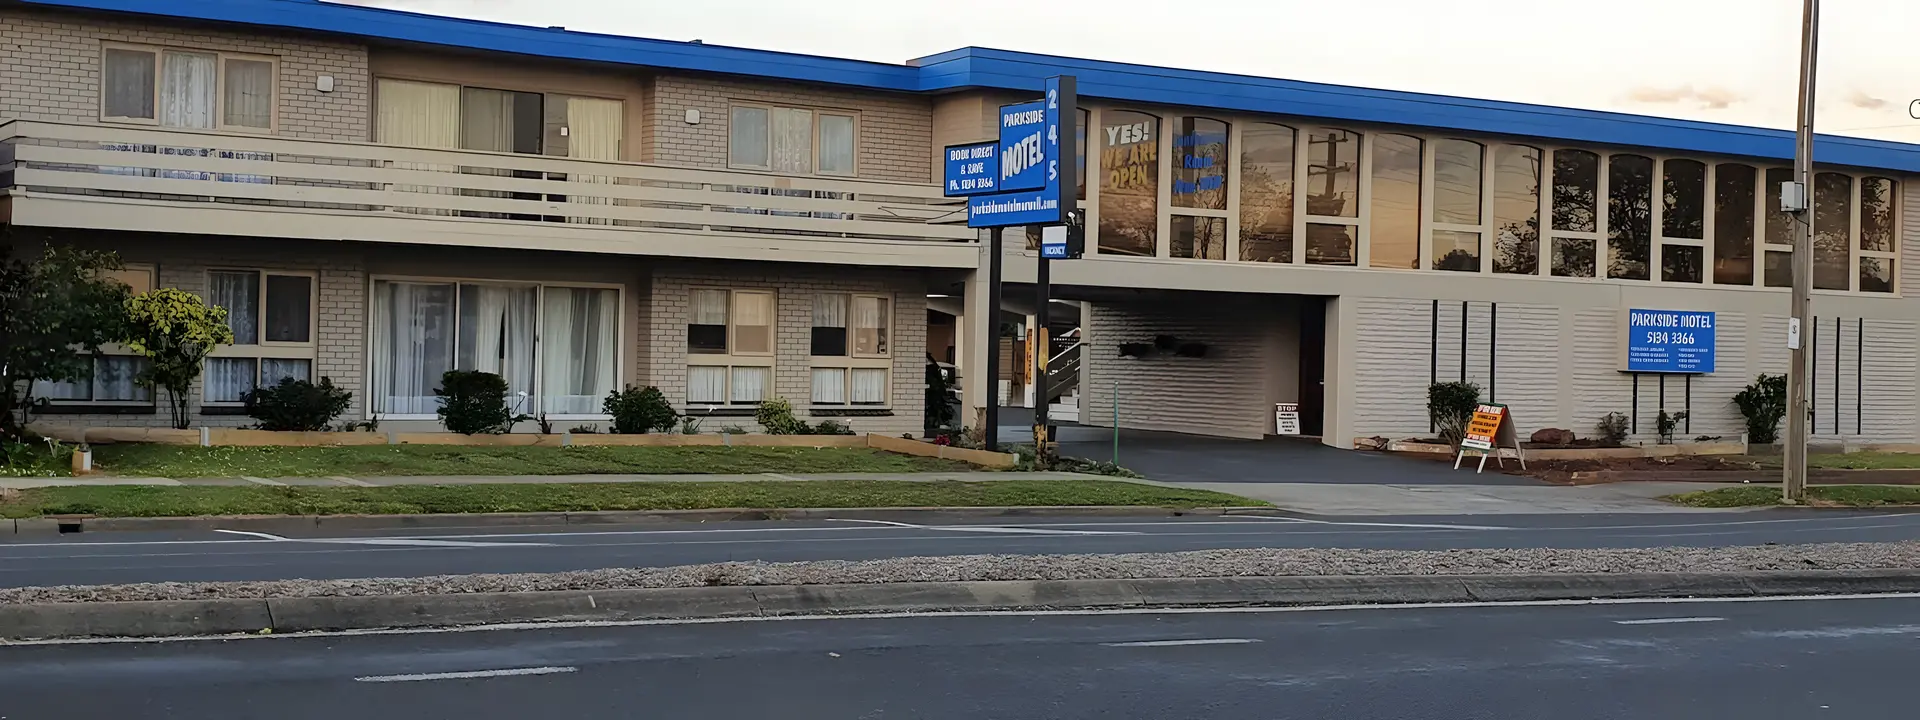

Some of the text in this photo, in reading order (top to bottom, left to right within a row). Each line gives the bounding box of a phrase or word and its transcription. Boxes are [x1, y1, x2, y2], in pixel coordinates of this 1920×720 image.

[1003, 109, 1044, 128] PARKSIDE
[1106, 121, 1150, 146] YES!
[951, 146, 993, 161] BOOK DIRECT
[1002, 131, 1044, 181] MOTEL
[1102, 141, 1156, 169] WE ARE
[1110, 165, 1148, 190] OPEN
[1631, 312, 1712, 328] PARKSIDE MOTEL
[1646, 331, 1695, 345] 5134 3366
